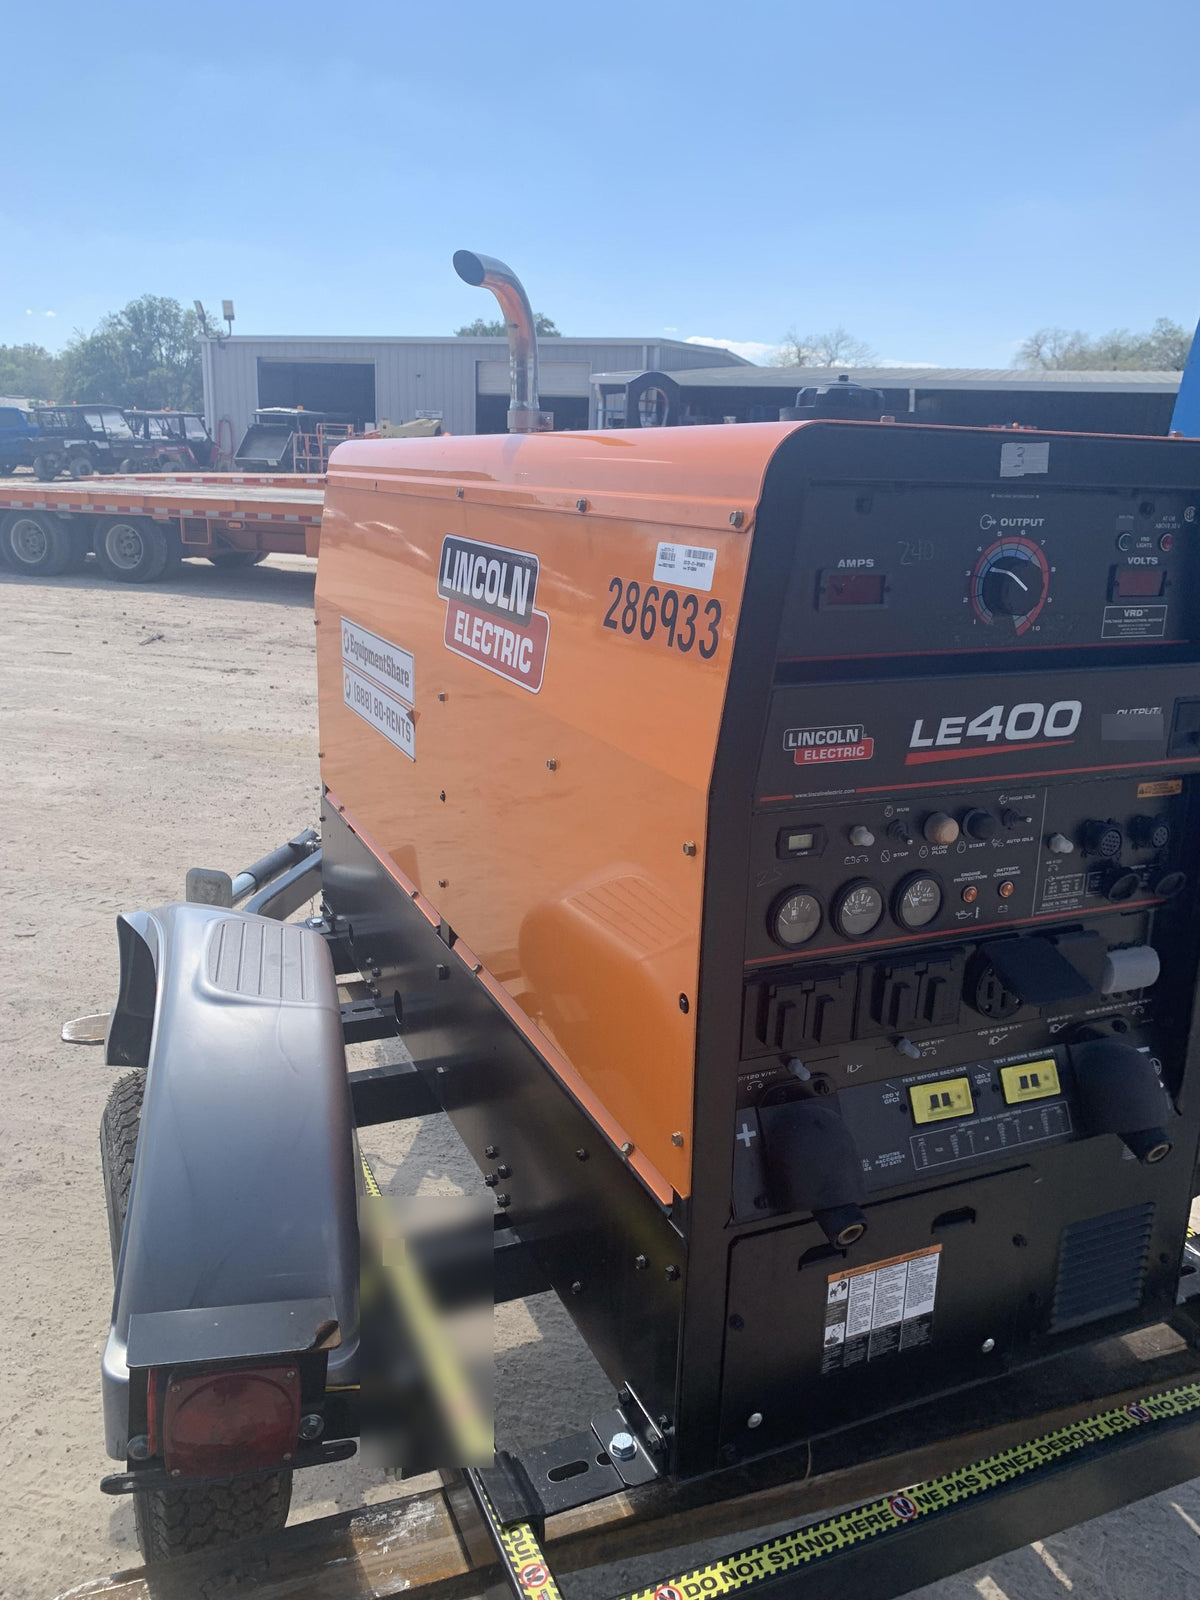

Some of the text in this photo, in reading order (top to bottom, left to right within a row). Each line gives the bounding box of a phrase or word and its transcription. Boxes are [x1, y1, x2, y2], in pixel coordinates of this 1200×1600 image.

[1000, 517, 1045, 527] OUTPUT
[837, 558, 875, 568] AMPS
[1127, 557, 1159, 565] VOLTS
[442, 548, 531, 616] LINCOLN
[604, 577, 721, 659] 286933
[454, 610, 533, 673] ELECTRIC
[350, 633, 409, 688] EquipmentShare
[353, 682, 411, 743] (888) 80-RENTS
[909, 700, 1083, 748] LE400
[788, 729, 859, 747] LINCOLN
[804, 746, 866, 761] ELECTRIC
[794, 788, 856, 798] www.lincolnelectric.com
[993, 870, 1021, 878] CHARGING
[995, 865, 1020, 873] BATTERY
[953, 874, 988, 883] PROTECTION
[1008, 1055, 1029, 1063] BEFORE
[1030, 1051, 1043, 1059] EACH
[918, 1072, 939, 1081] BEFORE
[940, 1069, 954, 1077] EACH
[882, 1092, 895, 1100] 120
[884, 1097, 900, 1105] GFCI
[1147, 1392, 1199, 1413] NO SE
[913, 1413, 1131, 1507] NE PAS TENEZ DEBOUT ICI
[683, 1509, 894, 1598] DO NOT STAND HERE
